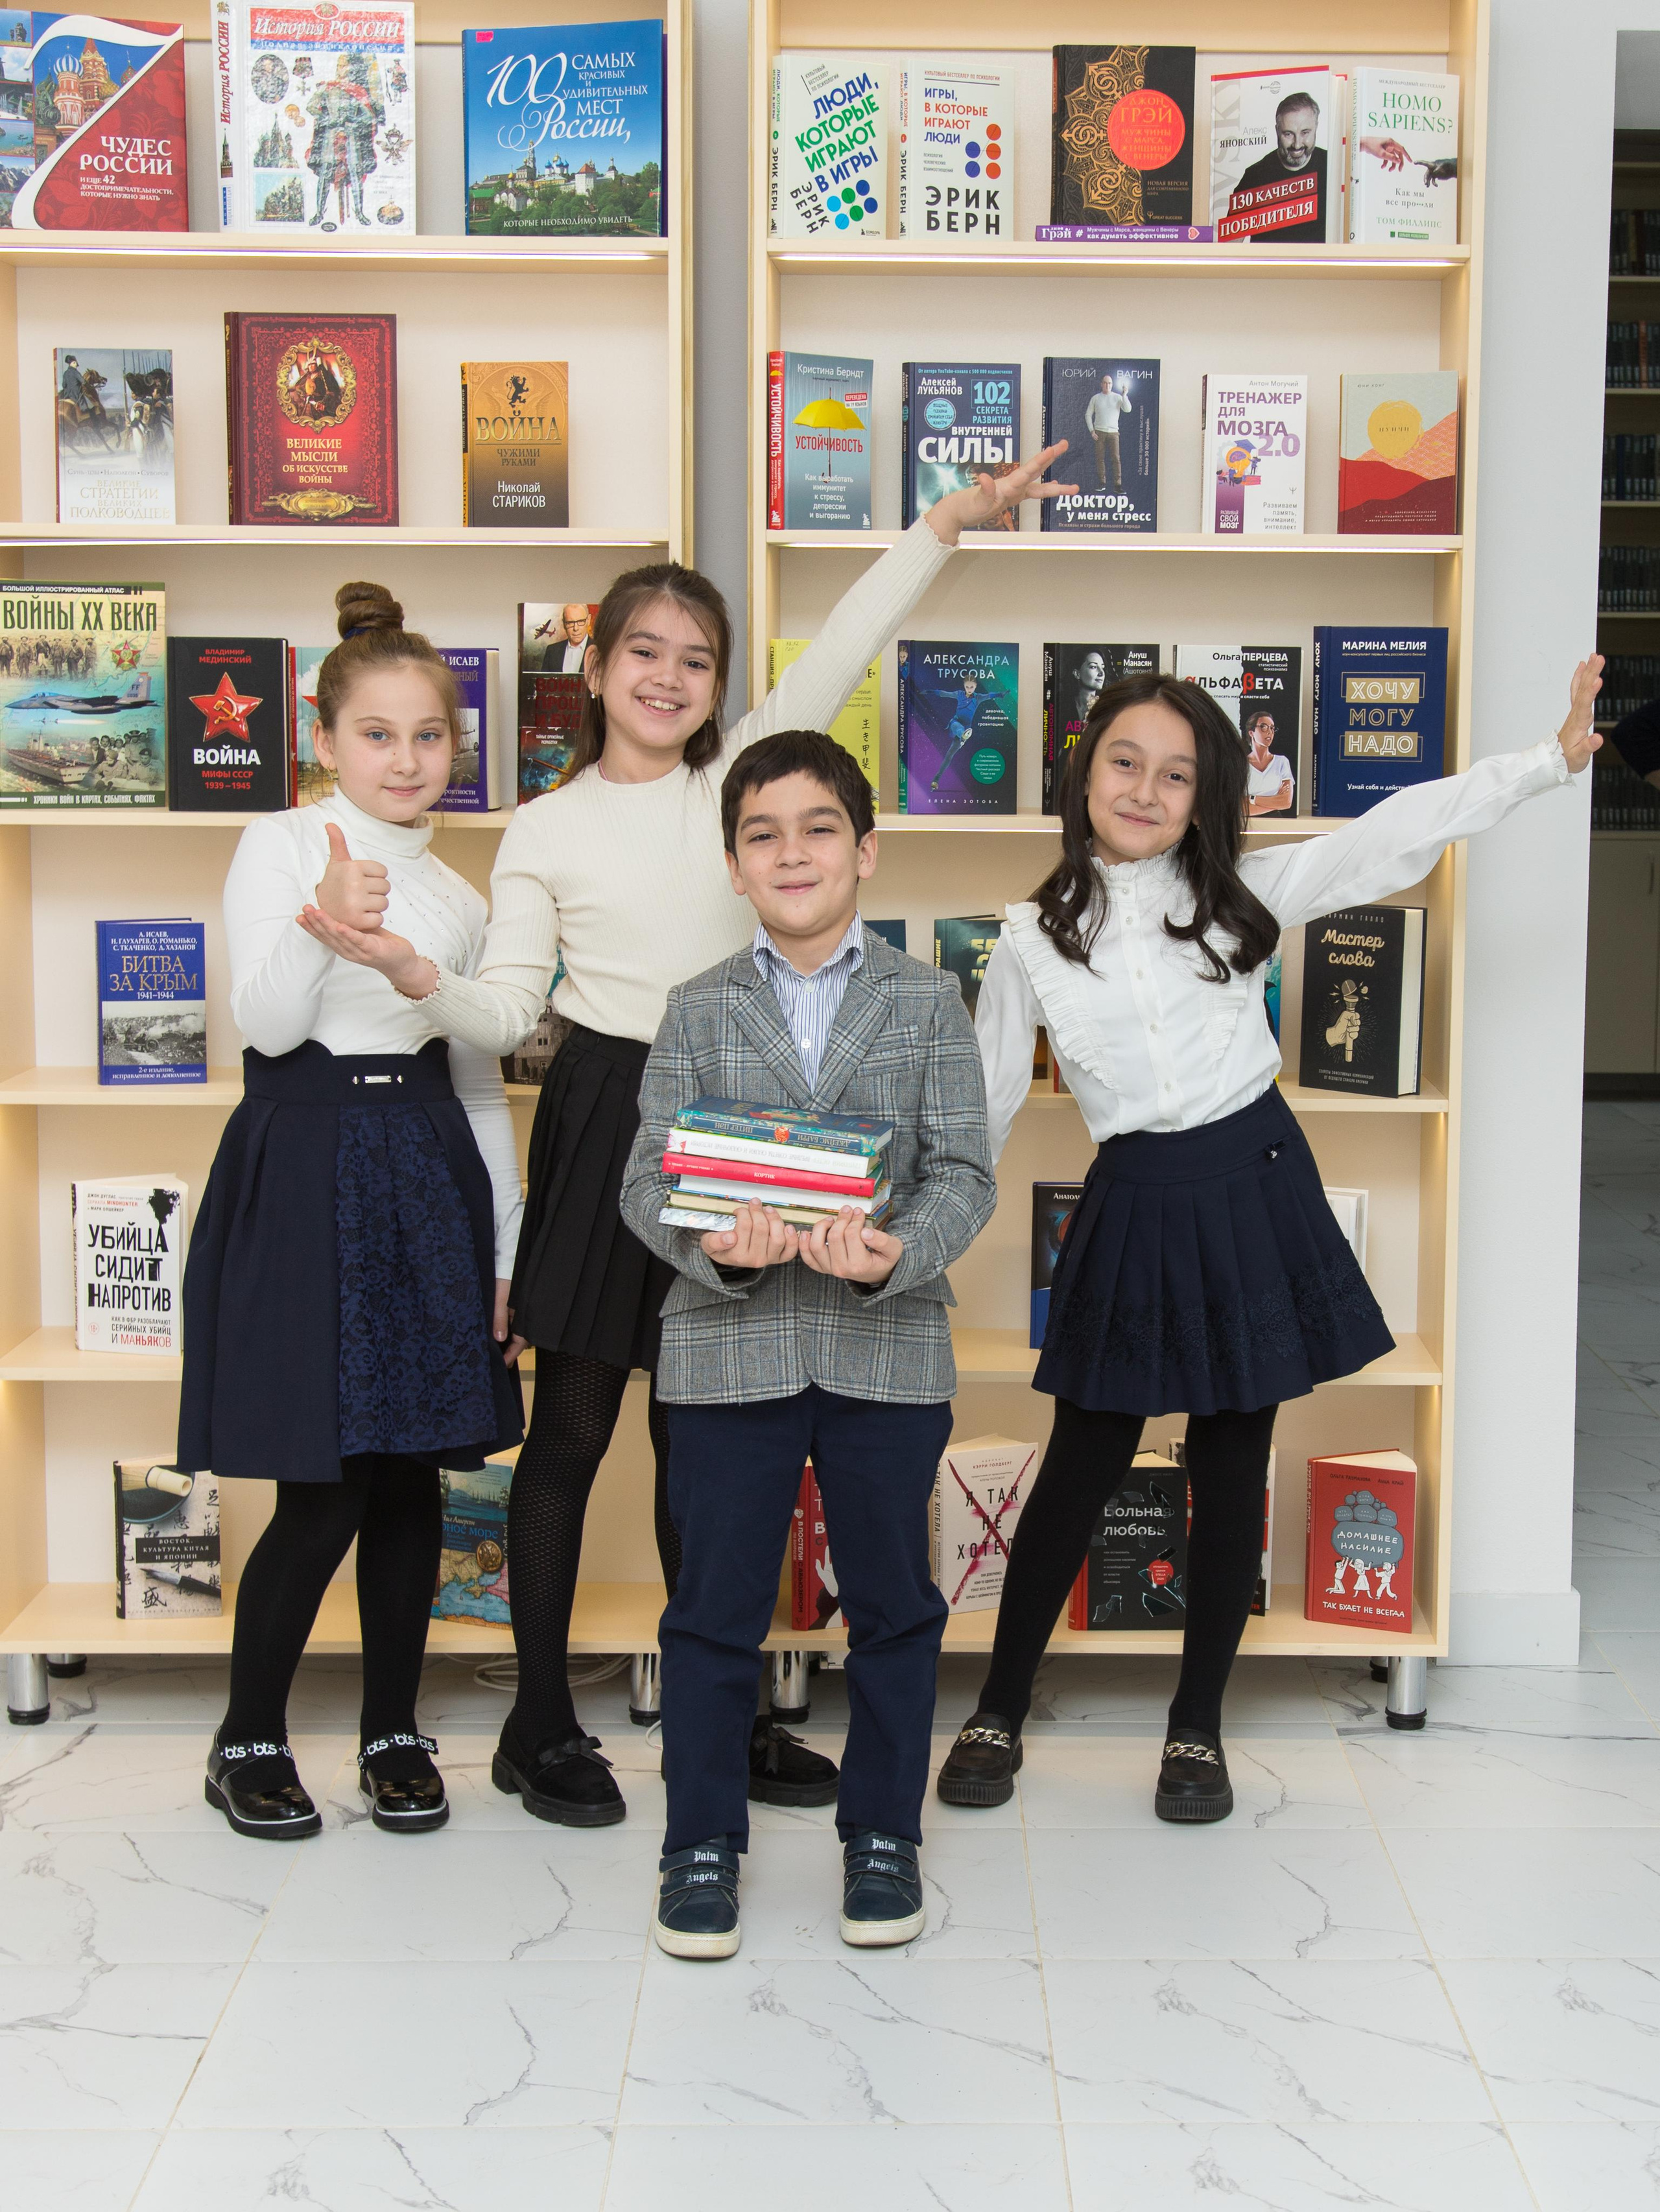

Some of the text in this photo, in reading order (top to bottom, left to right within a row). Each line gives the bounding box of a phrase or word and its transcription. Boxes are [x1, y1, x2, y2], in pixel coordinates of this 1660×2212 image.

[254, 18, 401, 38] История РОССИИ
[572, 52, 635, 69] САМЫХ
[487, 52, 567, 108] 100
[578, 70, 625, 80] КРАСИВЫХ
[562, 85, 648, 99] УДИВИТЕЛЬНЫХ
[813, 72, 880, 119] ЛЮДИ,
[925, 88, 957, 101] ИГРЫ,
[576, 99, 623, 115] МЕСТ
[1382, 92, 1441, 112] HOMO
[925, 102, 988, 117] В КОТОРЫЕ
[1120, 104, 1172, 123] ГРЭЙ
[497, 94, 631, 151] России,
[794, 94, 880, 152] КОТОРЫЕ
[925, 117, 971, 130] ИГРАЮТ
[1368, 112, 1453, 134] SAPIENS?
[924, 132, 960, 145] ЛЮДИ
[1220, 137, 1267, 148] ЯНОВСКИЙ
[101, 136, 171, 157] ЧУДЕС
[805, 121, 877, 173] ИГРАЮТ
[80, 154, 172, 175] РОССИИ
[815, 146, 879, 193] В ИГРЫ
[103, 175, 115, 184] 42
[925, 185, 1000, 209] ЭРИК
[1231, 178, 1314, 211] 130 КАЧЕСТВ
[1395, 188, 1410, 196] Как
[504, 216, 632, 228] КОТОРЫЕ НЕОБХОДИМО УВИДЕТЬ
[927, 210, 1000, 235] БЕРН
[1220, 201, 1314, 237] ПОБЕДИТЕЛЯ
[1397, 218, 1441, 228] ФИЛЛИПС
[797, 363, 864, 379] Кристина Берндт
[1061, 368, 1153, 379] ЮРИЙ ВАГИН
[921, 377, 956, 387] Алексей
[917, 386, 963, 396] ЛУКЬЯНОВ
[973, 381, 1010, 405] 102
[1218, 392, 1302, 405] ТРЕНАЖЕР
[976, 406, 1008, 415] СЕКРЕТА
[1218, 406, 1245, 418] ДЛЯ
[475, 410, 562, 441] ВОЙНА
[973, 416, 1012, 424] РАЗВИТИЯ
[951, 425, 1012, 436] ВНУТРЕННЕЙ
[1217, 421, 1288, 436] МОЗГА
[287, 438, 342, 450] ВЕЛИКИЕ
[796, 434, 863, 453] УСТОЙЧИВОСТЬ
[1257, 434, 1301, 456] 2.0
[290, 452, 338, 462] МЫСЛИ
[497, 449, 540, 457] ЧУЖИМИ
[918, 438, 1013, 464] СИЛЫ
[296, 464, 348, 474] ИСКУССТВЕ
[299, 473, 333, 484] ВОЙНЫ
[80, 487, 159, 499] СТРАТЕГИИ
[498, 481, 540, 493] Николай
[812, 484, 846, 493] иммунитет
[492, 495, 546, 508] СТАРИКОВ
[813, 502, 846, 511] депрессии
[1056, 494, 1134, 513] Доктор,
[816, 512, 850, 521] выгоранию
[1067, 512, 1074, 523] у
[1112, 512, 1151, 523] стресс
[3, 594, 74, 630] ВОЙНЫ
[111, 602, 156, 631] ВЕКА
[1342, 641, 1427, 650] МАРИНА МЕЛИЯ
[199, 655, 252, 664] МЕДИНСКИЙ
[449, 655, 479, 666] ИСАЕВ
[923, 654, 1009, 666] АЛЕКСАНДРА
[1128, 651, 1147, 659] Ануш
[1213, 652, 1288, 662] Ольга ПЕРЦЕВА
[938, 668, 995, 679] ТРУСОВА
[1351, 681, 1416, 700] ХОЧУ
[1349, 709, 1414, 726] МОГУ
[1348, 735, 1414, 756] НАДО
[193, 745, 261, 765] ВОЙНА
[1321, 929, 1384, 951] Мастер
[122, 956, 185, 972] БИТВА
[1329, 950, 1375, 967] слова
[110, 974, 198, 991] ЗА КРЫМ
[729, 1125, 753, 1134] ПИТЕР
[797, 1135, 821, 1143] БАРРИ
[88, 1221, 169, 1255] УБИЙЦА
[95, 1254, 163, 1282] СИДИТ
[88, 1283, 171, 1312] НАПРОТИВ
[112, 1324, 171, 1335] СЕРИЙНЫХ УБИЙЦ
[121, 1334, 171, 1347] МАНЬЯКОВ
[966, 1486, 1019, 1507] Я ТАК
[1104, 1505, 1172, 1518] Больная
[982, 1514, 1002, 1531] НЕ
[469, 1527, 498, 1540] море
[1103, 1524, 1166, 1536] любовь
[1337, 1531, 1399, 1544] ДОМАШНЕЕ
[1340, 1542, 1391, 1555] НАСИЛИЕ
[1323, 1601, 1336, 1610] ТАК
[1339, 1603, 1360, 1612] БУДЕТ
[1376, 1608, 1405, 1618] ВСЕГДА
[225, 1743, 277, 1759] bts bts
[367, 1734, 434, 1755] bts bts bts
[872, 1838, 896, 1852] Palm
[694, 1850, 719, 1863] Palm
[867, 1858, 899, 1873] Angels
[686, 1872, 718, 1885] Angels
